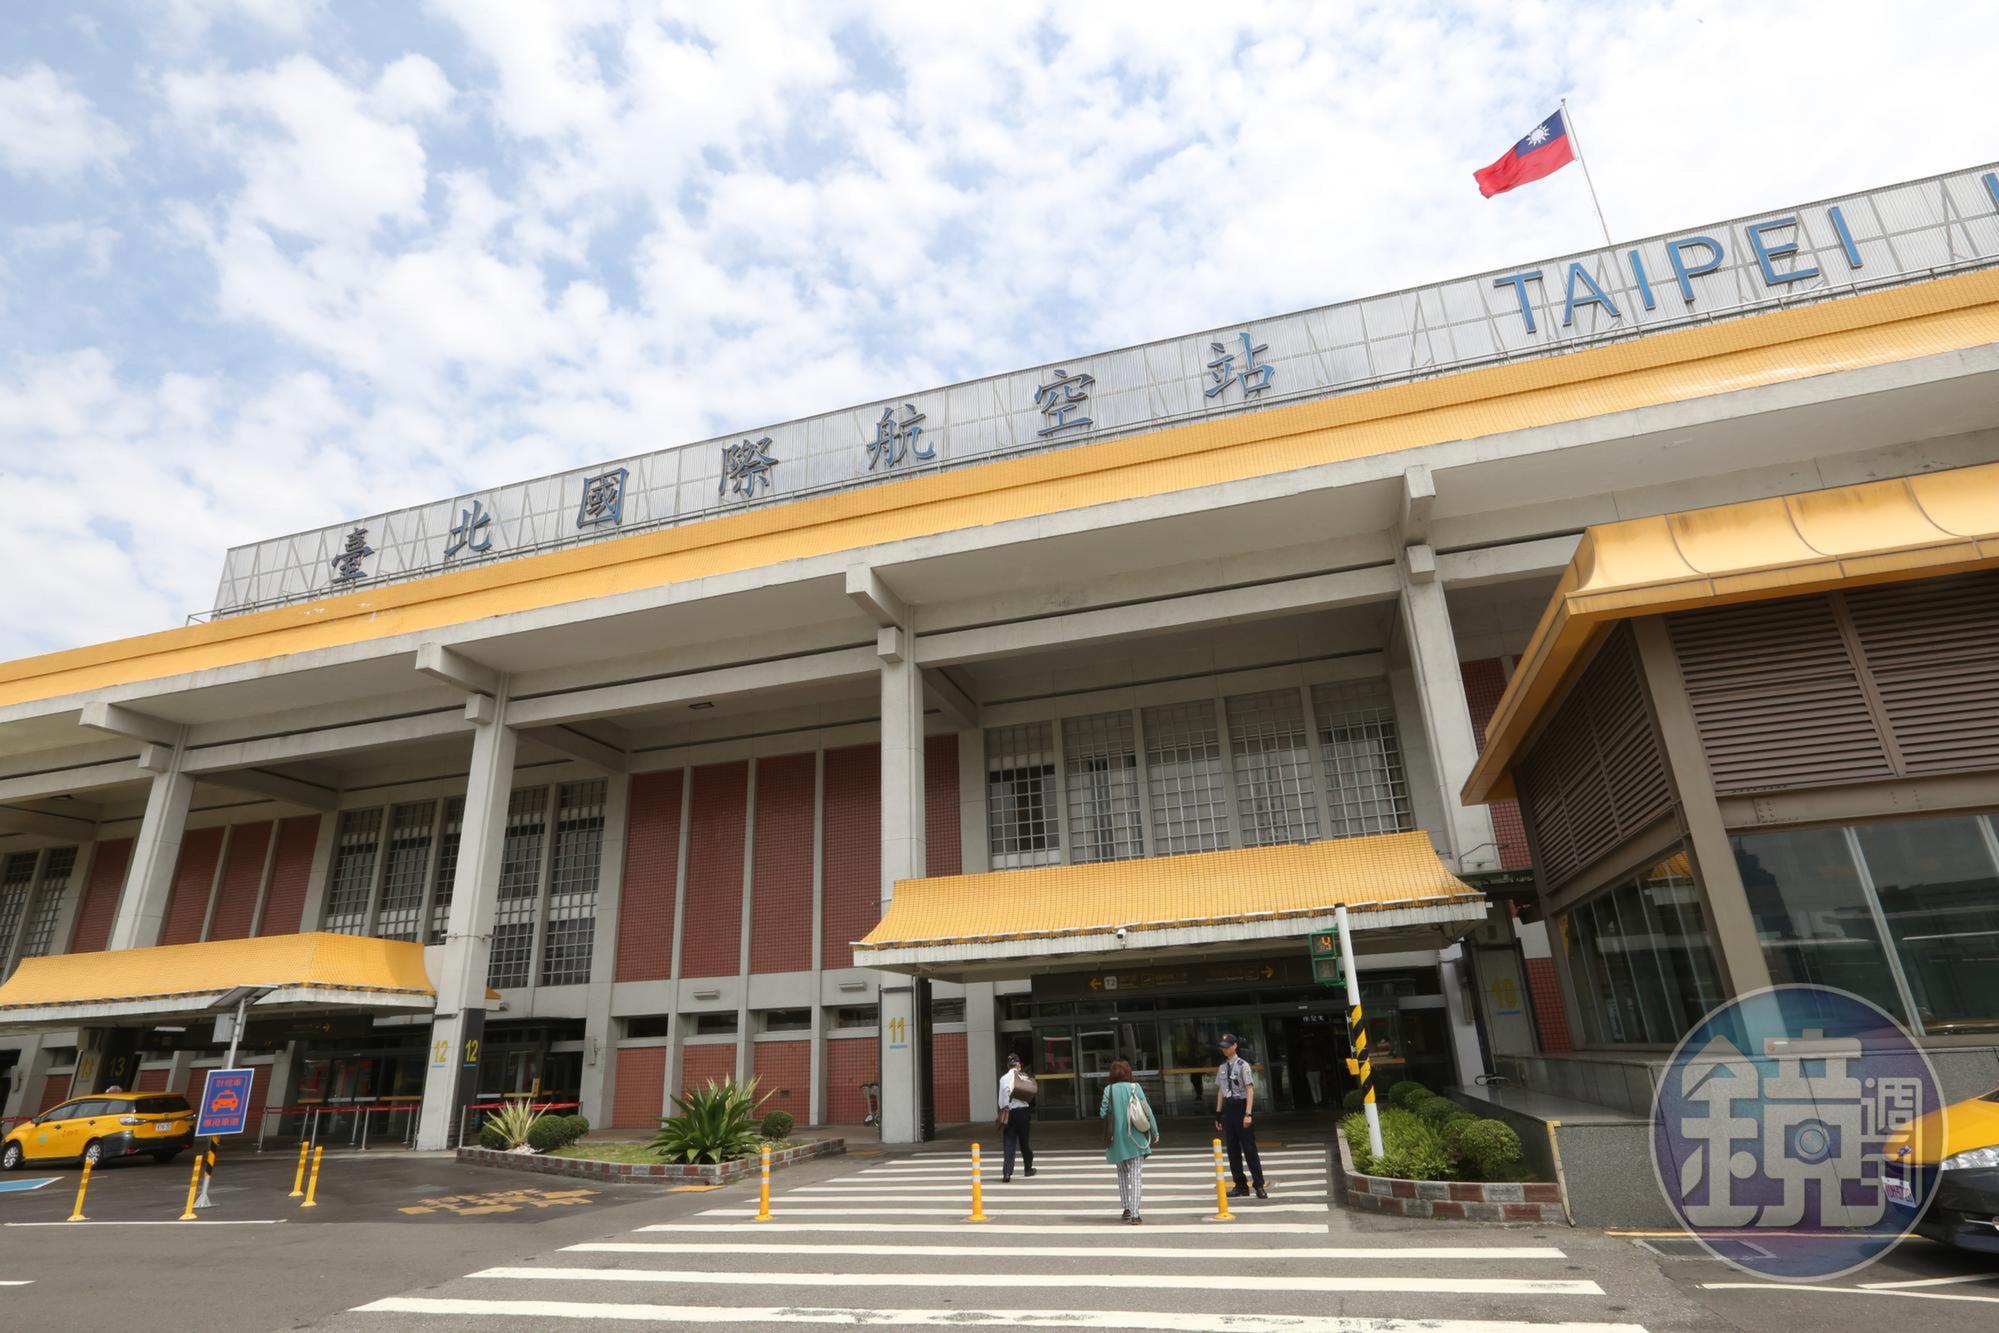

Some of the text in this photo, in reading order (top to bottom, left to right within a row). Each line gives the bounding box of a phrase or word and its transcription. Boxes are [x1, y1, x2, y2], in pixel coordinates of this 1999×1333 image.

[1494, 205, 1864, 335] TAIPEI
[330, 331, 1276, 585] 臺北國際航空站
[888, 1016, 905, 1043] 11
[434, 1039, 449, 1063] 12
[465, 1039, 479, 1062] 12
[110, 1056, 126, 1077] 13
